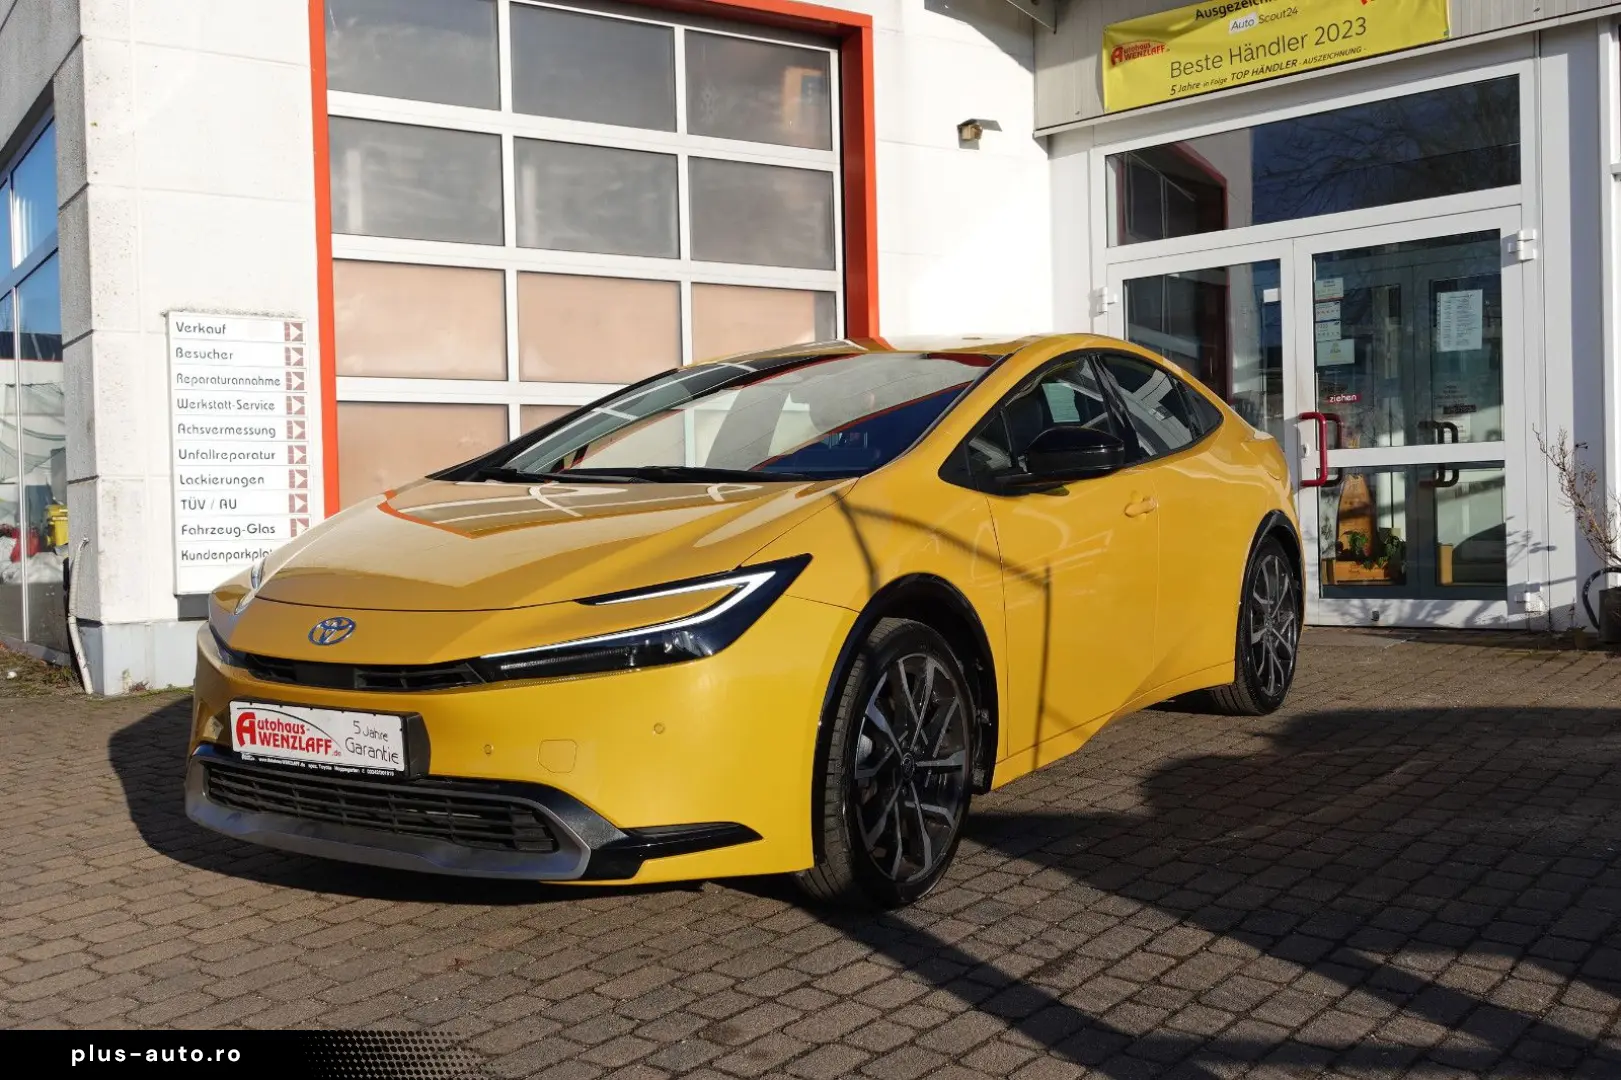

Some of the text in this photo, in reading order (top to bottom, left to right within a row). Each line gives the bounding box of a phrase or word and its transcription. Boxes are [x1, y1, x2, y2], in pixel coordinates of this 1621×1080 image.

[1195, 0, 1272, 20] Ausgezeic
[1230, 6, 1299, 31] Auto Scout24
[1124, 44, 1165, 60] WENZLAFF
[1170, 16, 1367, 79] Beste Händler 2023
[1170, 84, 1177, 96] 5
[1178, 81, 1201, 93] Jahre
[1210, 77, 1228, 88] Folge
[1231, 71, 1250, 82] TOP
[1251, 59, 1298, 77] HÄNDLER
[1302, 46, 1362, 66] AUSZEICHNUNG
[175, 322, 227, 335] Verkauf
[175, 347, 234, 361] Besucher
[176, 373, 281, 388] Reparaturannahme
[176, 398, 276, 412] Werkstatt-Service
[1329, 393, 1358, 403] ziehen
[177, 423, 277, 439] Achsvermessung
[178, 449, 277, 463] Unfallreparatur
[179, 474, 265, 488] Lackierungen
[180, 496, 206, 512] TÜV
[219, 499, 238, 511] AU
[181, 523, 276, 538] Fahrzeug-Glas
[181, 548, 272, 563] Kundenparkpla
[353, 720, 389, 742] 5 Jahre
[345, 736, 400, 765] Garantie
